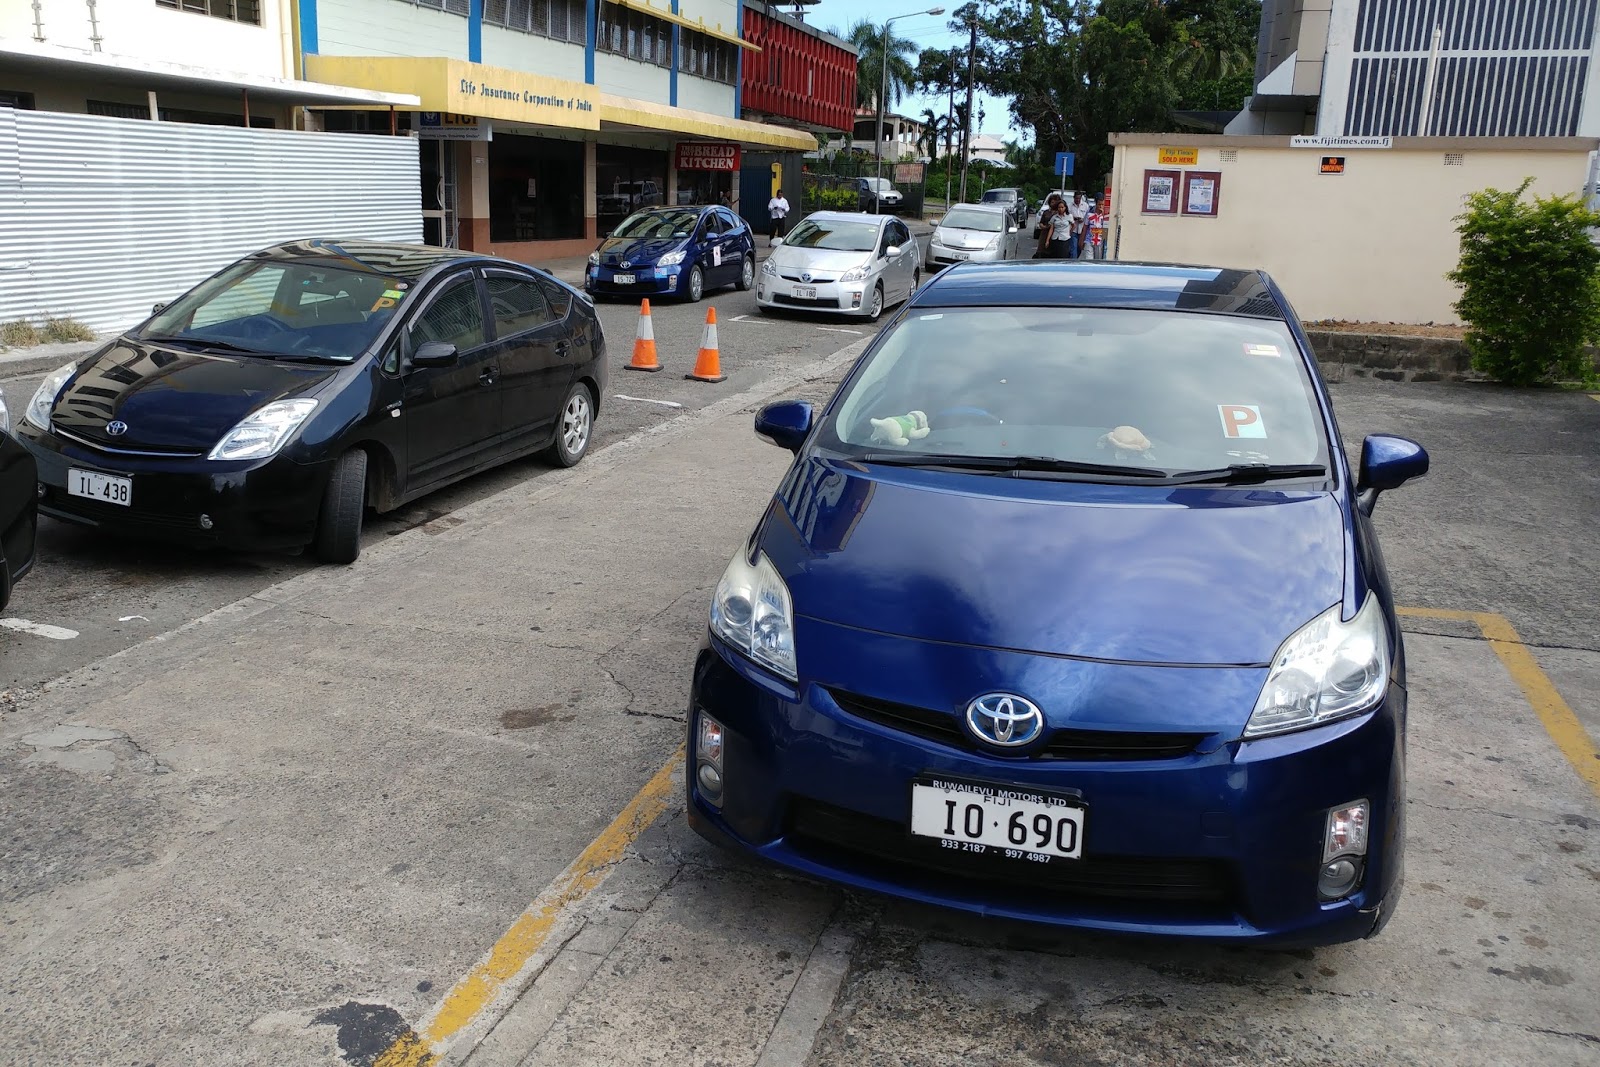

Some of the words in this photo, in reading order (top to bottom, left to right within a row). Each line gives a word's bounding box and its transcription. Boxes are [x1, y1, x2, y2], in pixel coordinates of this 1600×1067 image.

[460, 79, 476, 95] Life
[480, 83, 520, 101] Insurance
[523, 90, 564, 107] Corporation
[567, 98, 574, 110] of
[576, 99, 592, 112] India
[694, 146, 735, 157] BREAD
[680, 157, 734, 169] KITCHEN
[1321, 164, 1344, 172] SMOKING
[370, 297, 395, 312] P
[1221, 405, 1257, 437] P
[932, 780, 994, 796] RUWAILEVU
[998, 790, 1043, 804] MOTORS
[1047, 797, 1067, 807] LTD
[983, 795, 1011, 806] FIJI
[941, 839, 959, 849] 933
[962, 843, 986, 853] 2187
[1005, 849, 1023, 859] 997
[1026, 852, 1051, 863] 4987
